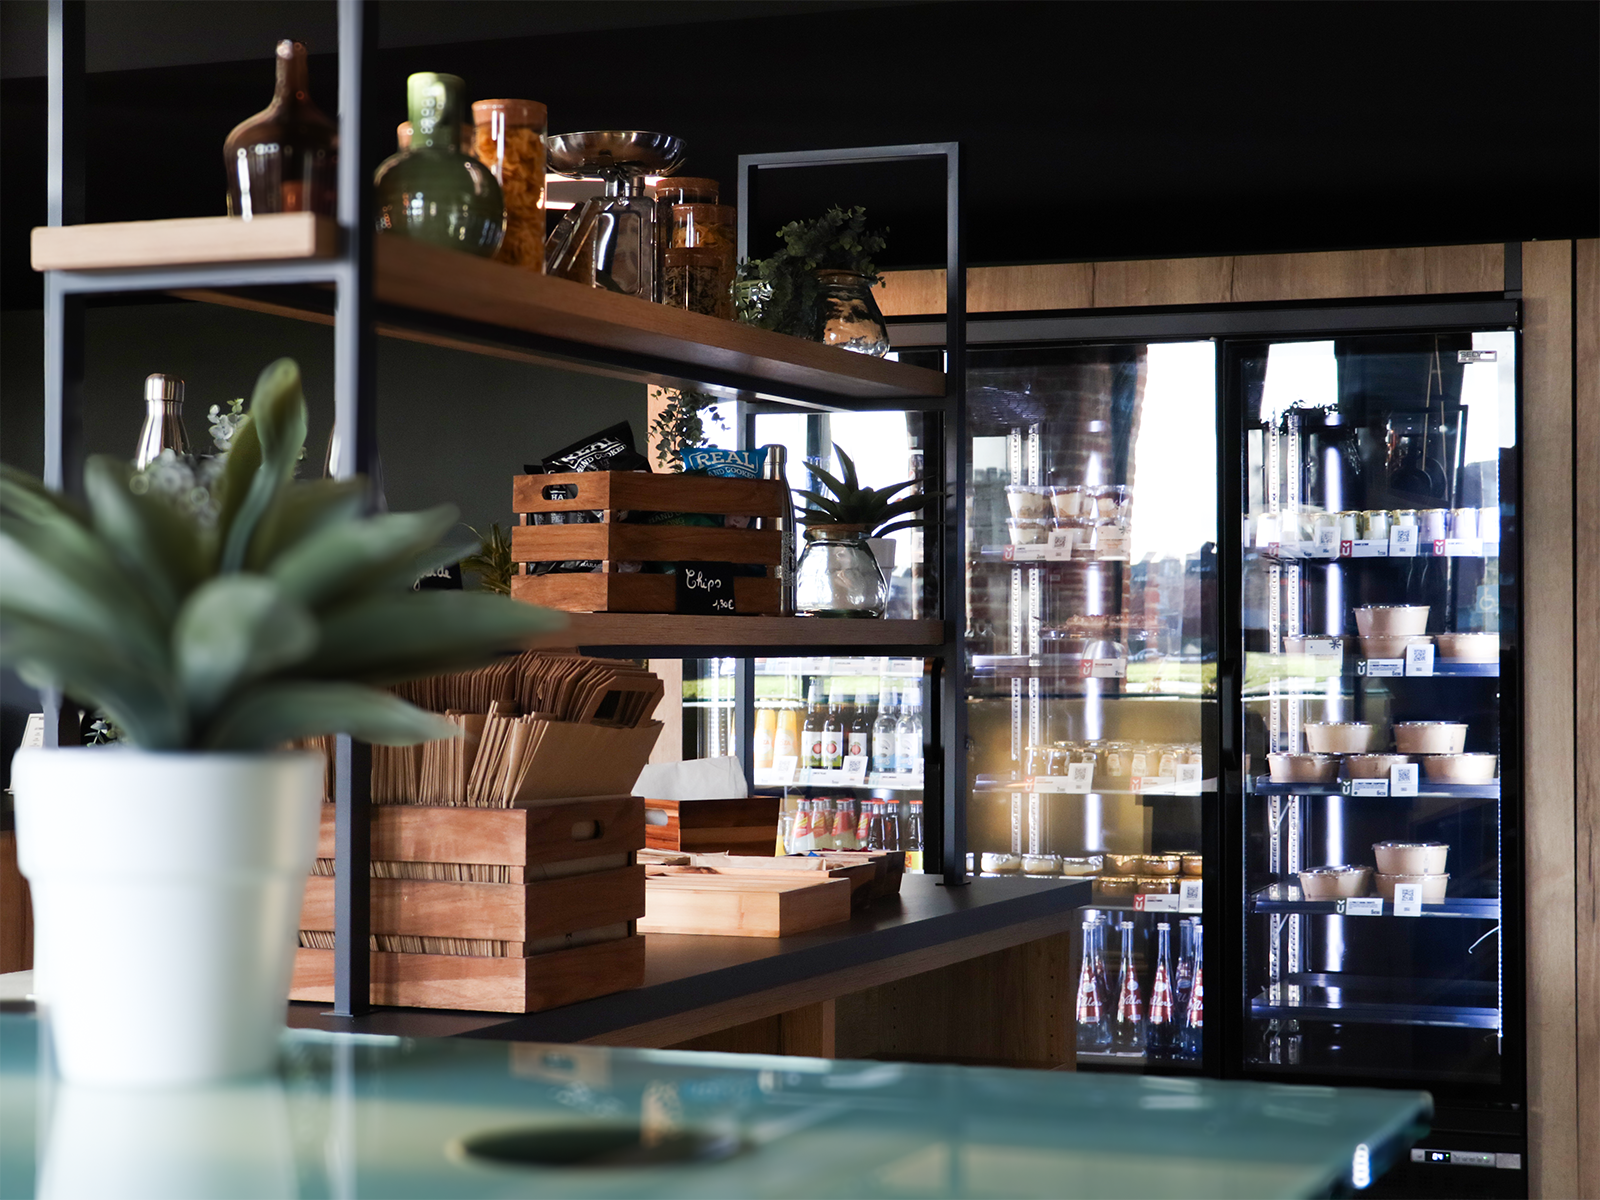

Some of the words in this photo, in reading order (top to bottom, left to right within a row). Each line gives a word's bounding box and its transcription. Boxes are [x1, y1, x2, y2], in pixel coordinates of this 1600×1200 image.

[695, 451, 755, 469] REAL
[708, 469, 725, 477] AND
[725, 467, 756, 479] COOKED
[685, 568, 722, 592] Chips
